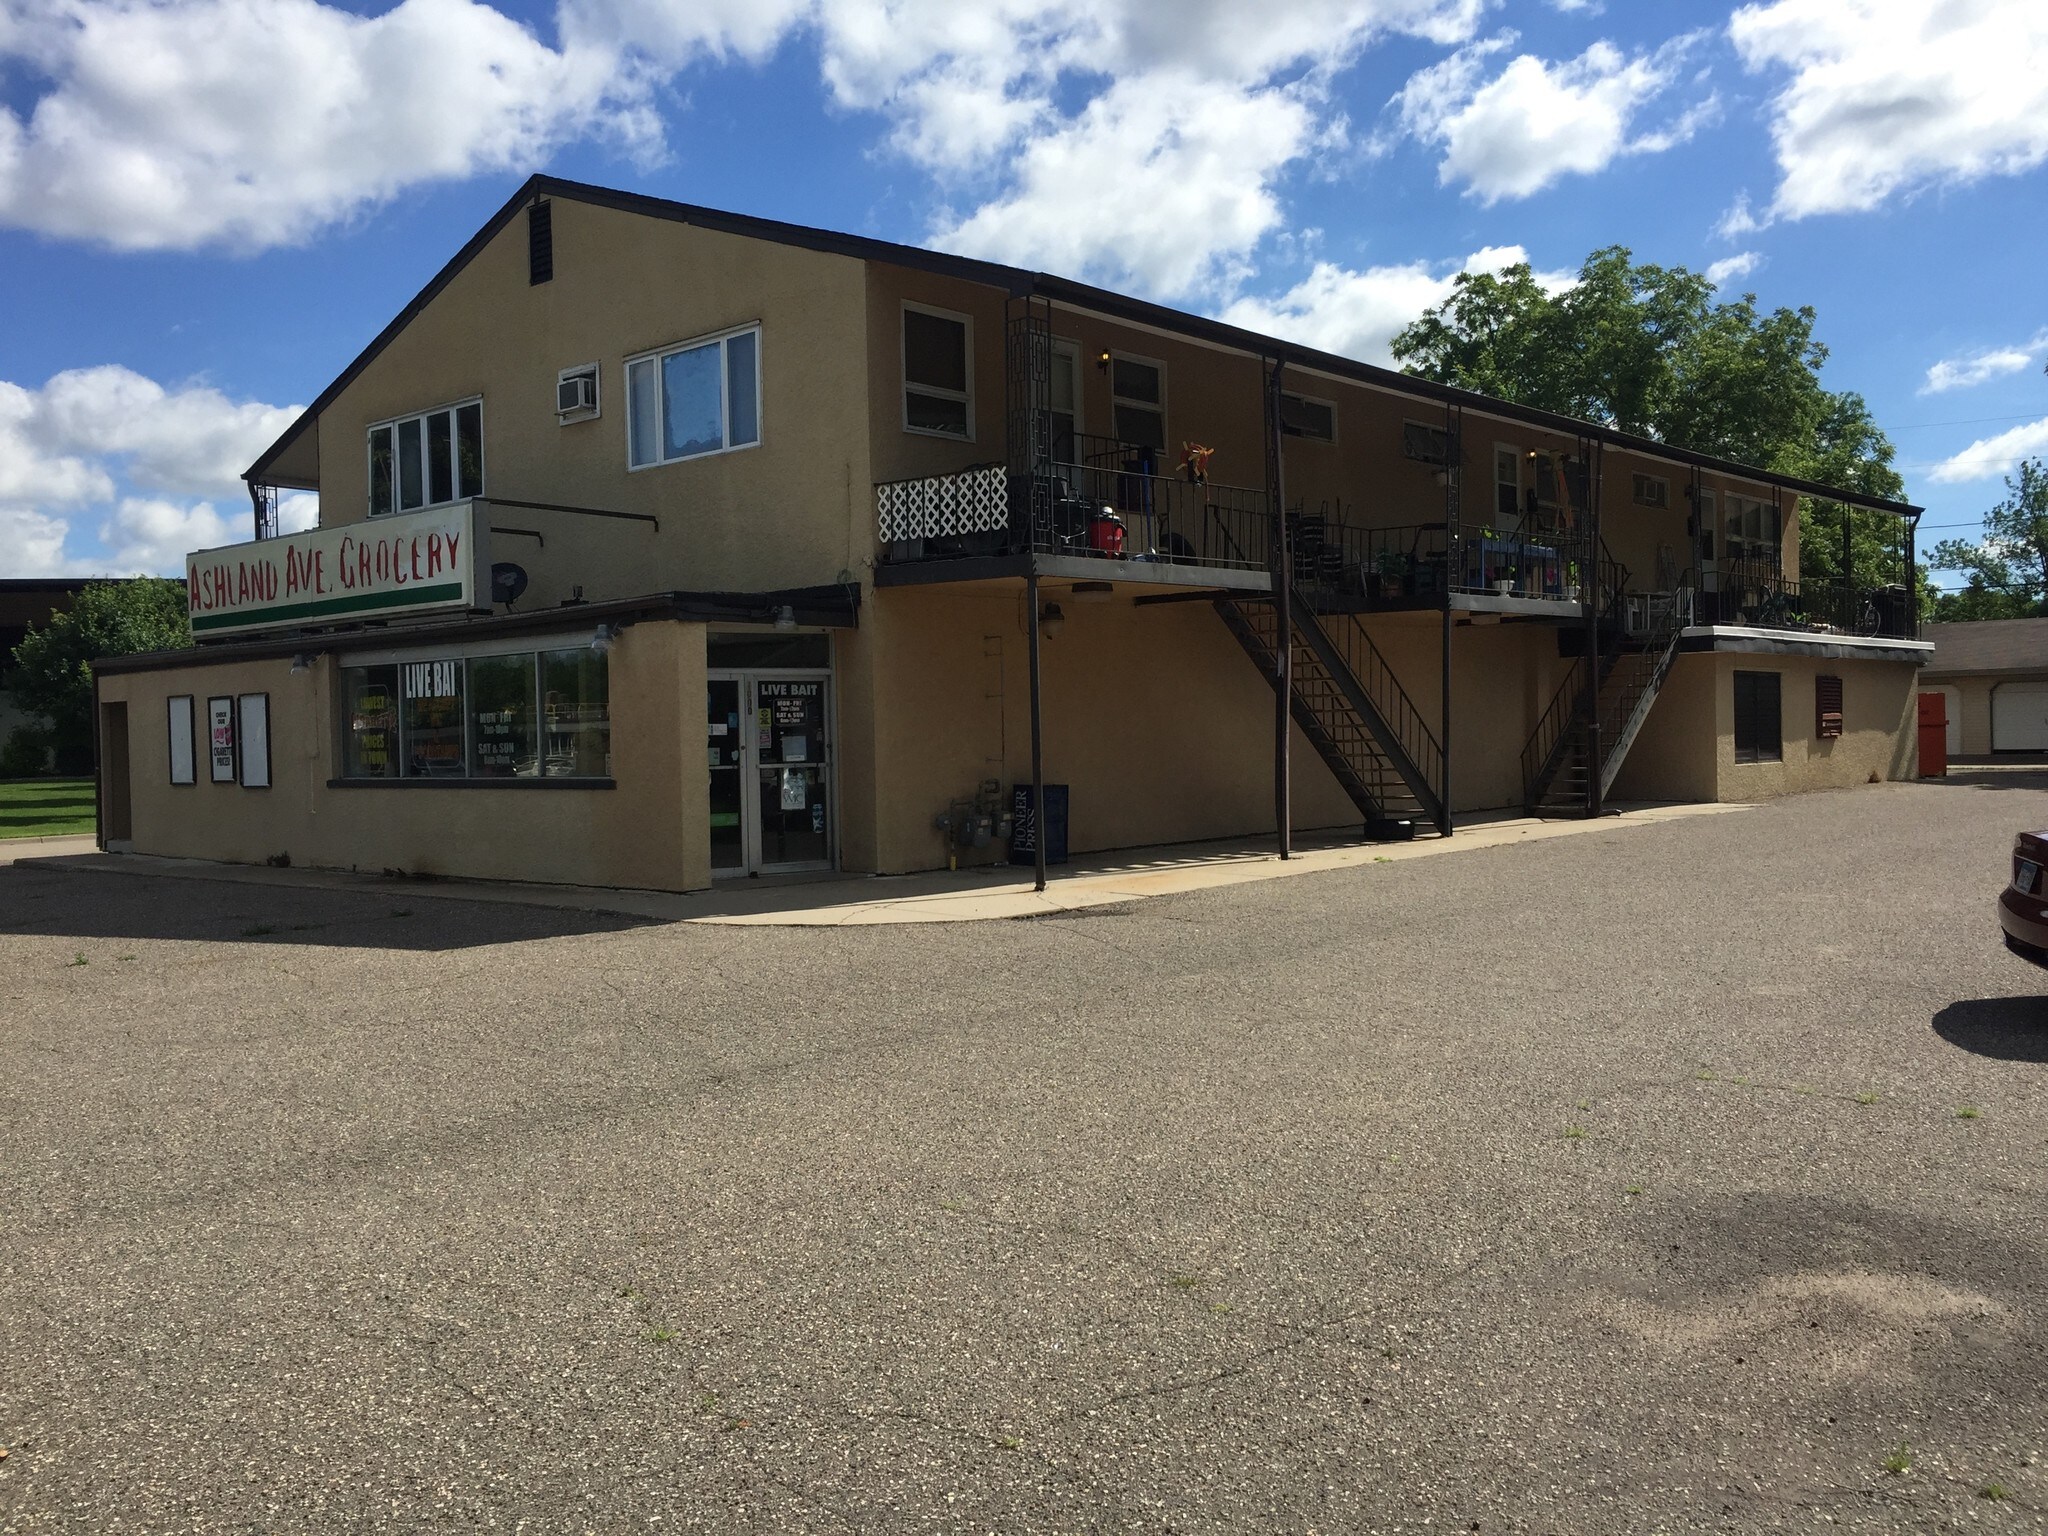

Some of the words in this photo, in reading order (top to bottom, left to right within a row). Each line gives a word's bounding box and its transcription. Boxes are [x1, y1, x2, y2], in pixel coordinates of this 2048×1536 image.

[190, 559, 277, 611] ASHLAND
[339, 532, 460, 589] GROCERY
[405, 663, 432, 699] LIVE
[761, 684, 787, 696] LIVE
[790, 684, 818, 696] BAIT
[478, 743, 492, 754] SAT
[492, 744, 498, 754] &
[499, 742, 515, 754] SUN
[1013, 790, 1027, 850] PIONEER
